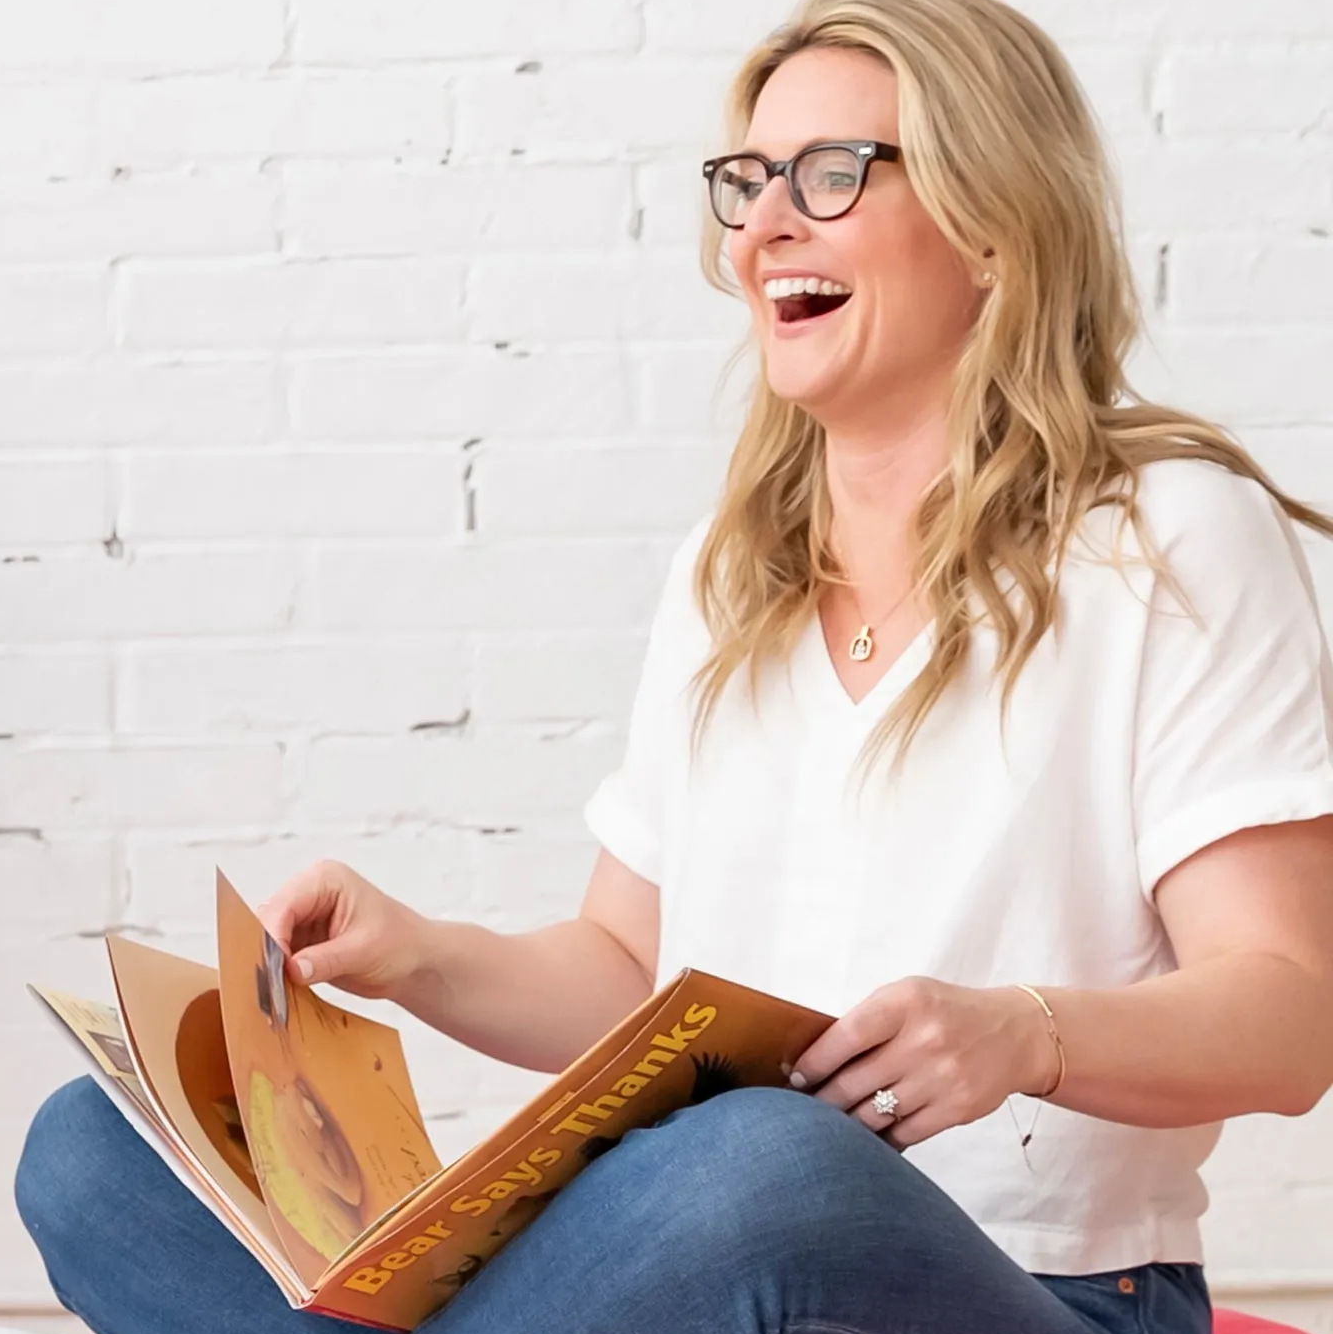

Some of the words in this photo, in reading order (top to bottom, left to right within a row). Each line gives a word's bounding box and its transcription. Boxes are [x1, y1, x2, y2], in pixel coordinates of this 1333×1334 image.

[342, 1218, 454, 1296] Bear
[450, 1146, 562, 1218] Says
[549, 1002, 718, 1137] Thanks
